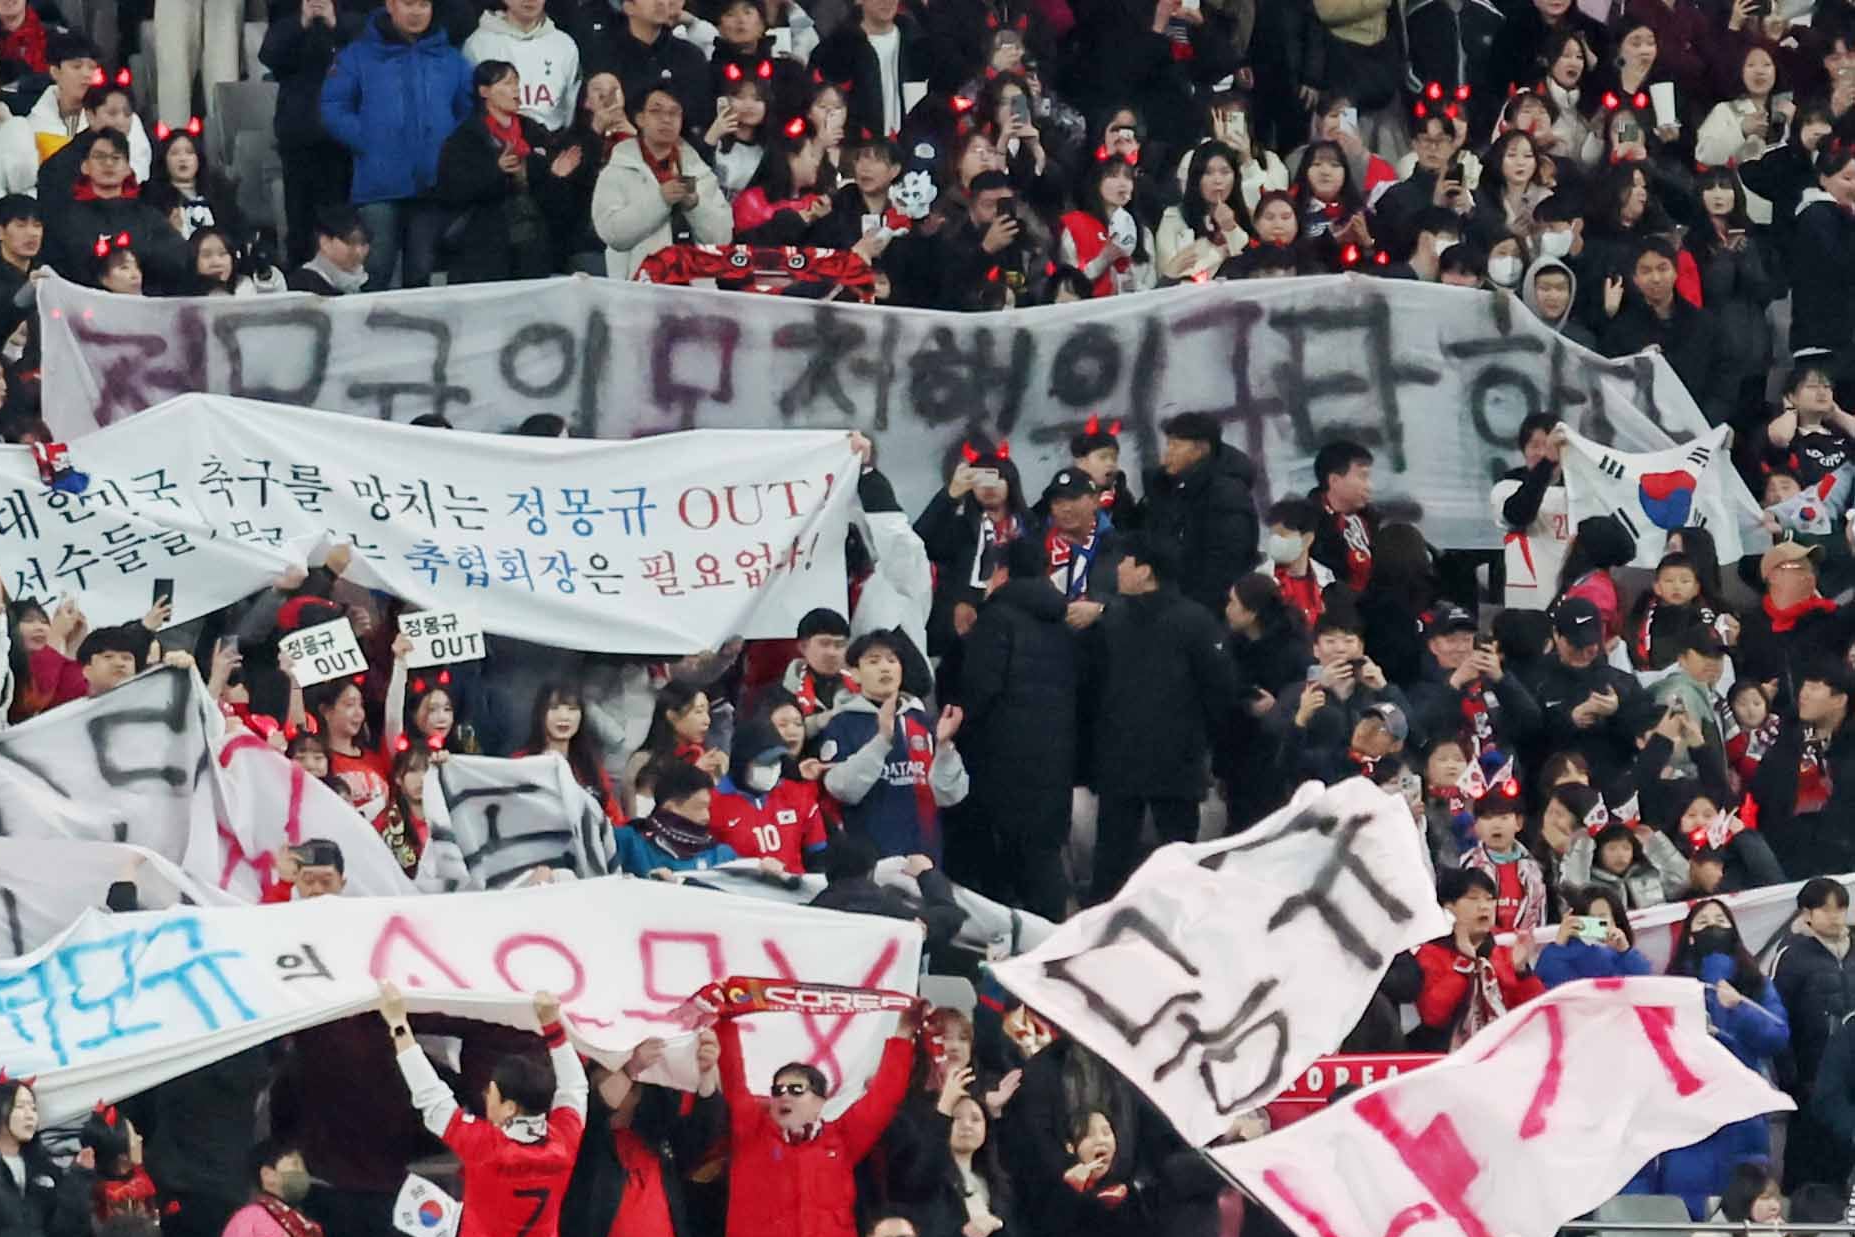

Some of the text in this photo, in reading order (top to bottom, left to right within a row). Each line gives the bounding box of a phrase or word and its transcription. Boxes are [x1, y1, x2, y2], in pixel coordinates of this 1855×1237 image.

[198, 454, 334, 514] 축구를
[350, 473, 488, 530] 망치는
[506, 486, 657, 537] 정몽규
[677, 473, 834, 530] OUT!
[403, 538, 625, 595] 축협회장은
[404, 613, 459, 638] 정몽규
[430, 633, 480, 660] OUT
[313, 648, 362, 675] OUT
[751, 823, 782, 853] 10
